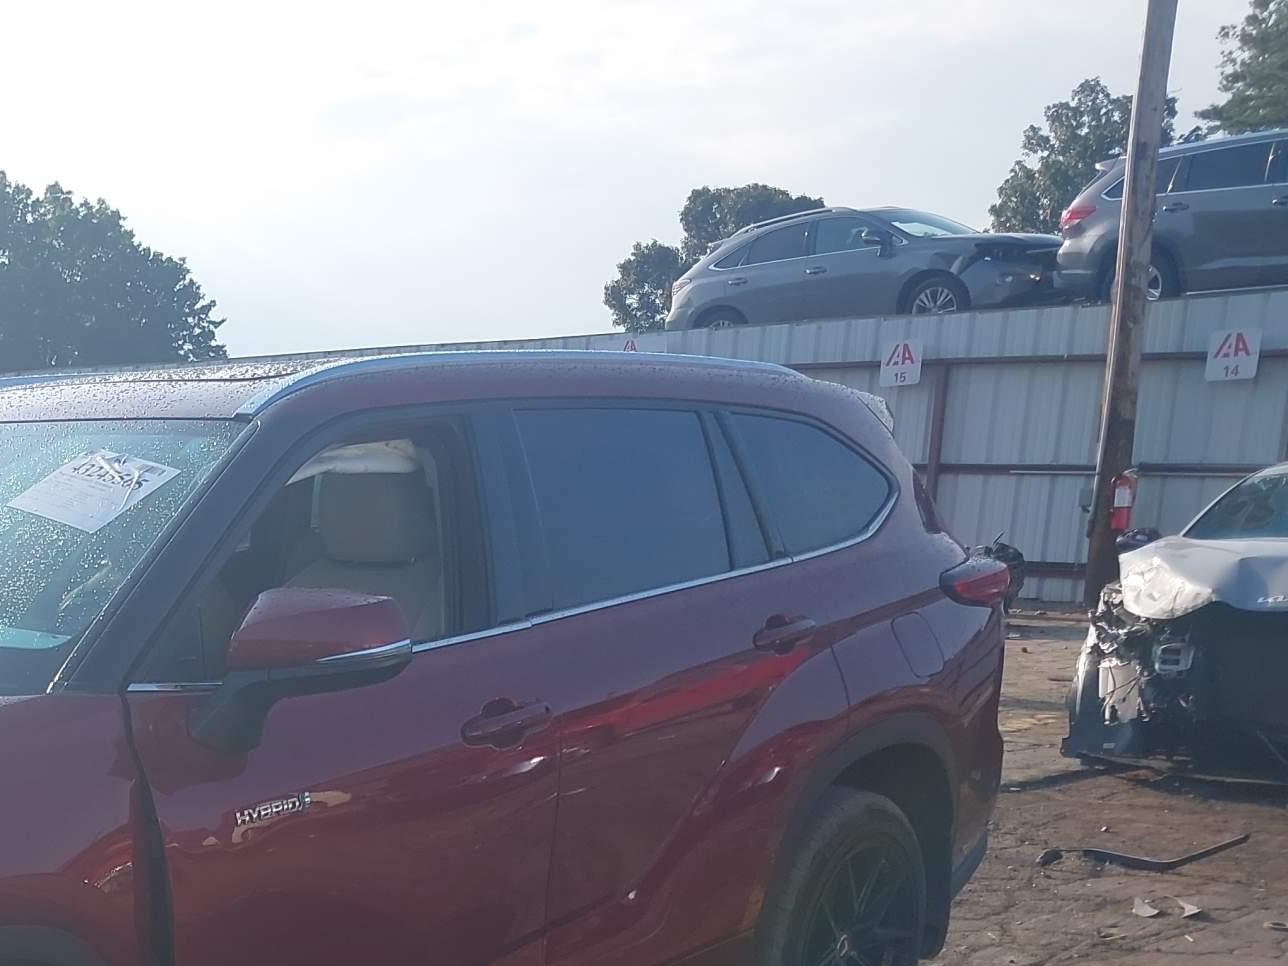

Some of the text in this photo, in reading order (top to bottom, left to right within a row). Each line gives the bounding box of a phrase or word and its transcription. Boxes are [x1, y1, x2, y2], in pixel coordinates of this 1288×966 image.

[894, 371, 907, 384] 15
[1223, 364, 1240, 378] 14
[235, 797, 302, 826] HYBRID
